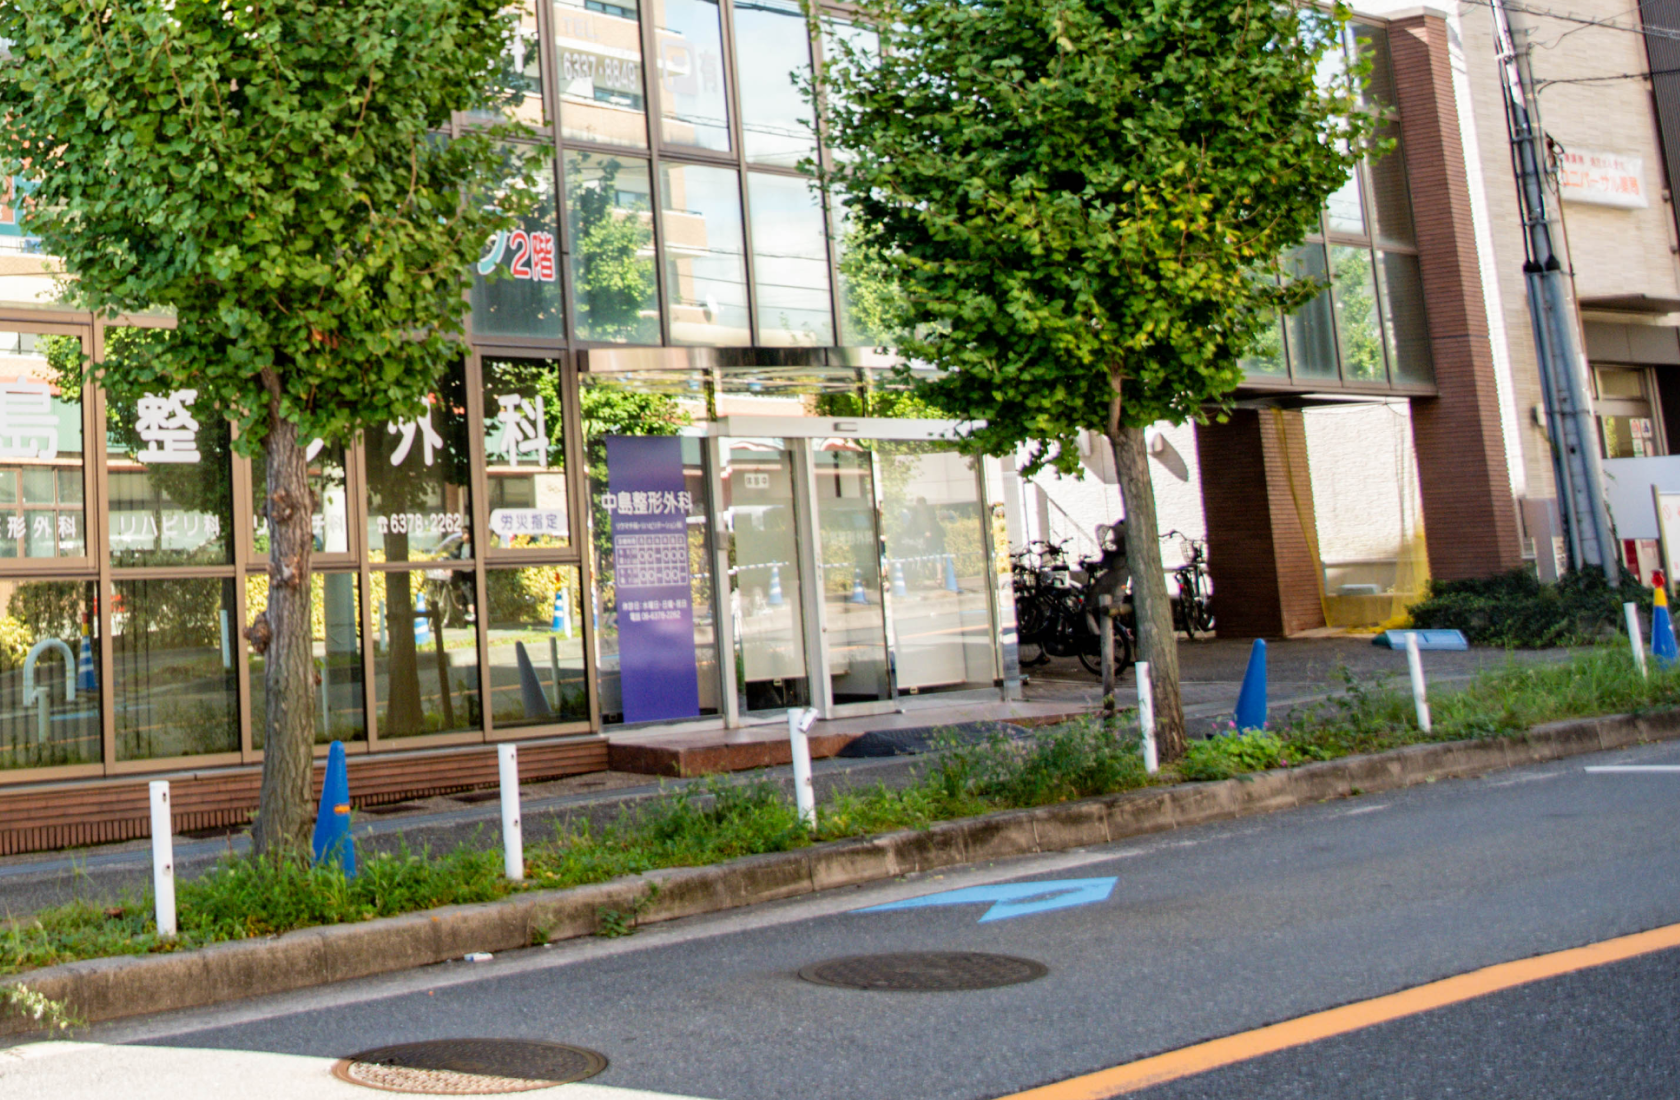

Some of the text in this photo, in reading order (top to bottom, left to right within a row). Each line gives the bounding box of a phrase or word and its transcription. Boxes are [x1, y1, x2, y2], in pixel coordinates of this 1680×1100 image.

[601, 490, 693, 515] 中島整形外科
[120, 514, 220, 537] リハビリ科
[500, 513, 558, 530] 労災指定
